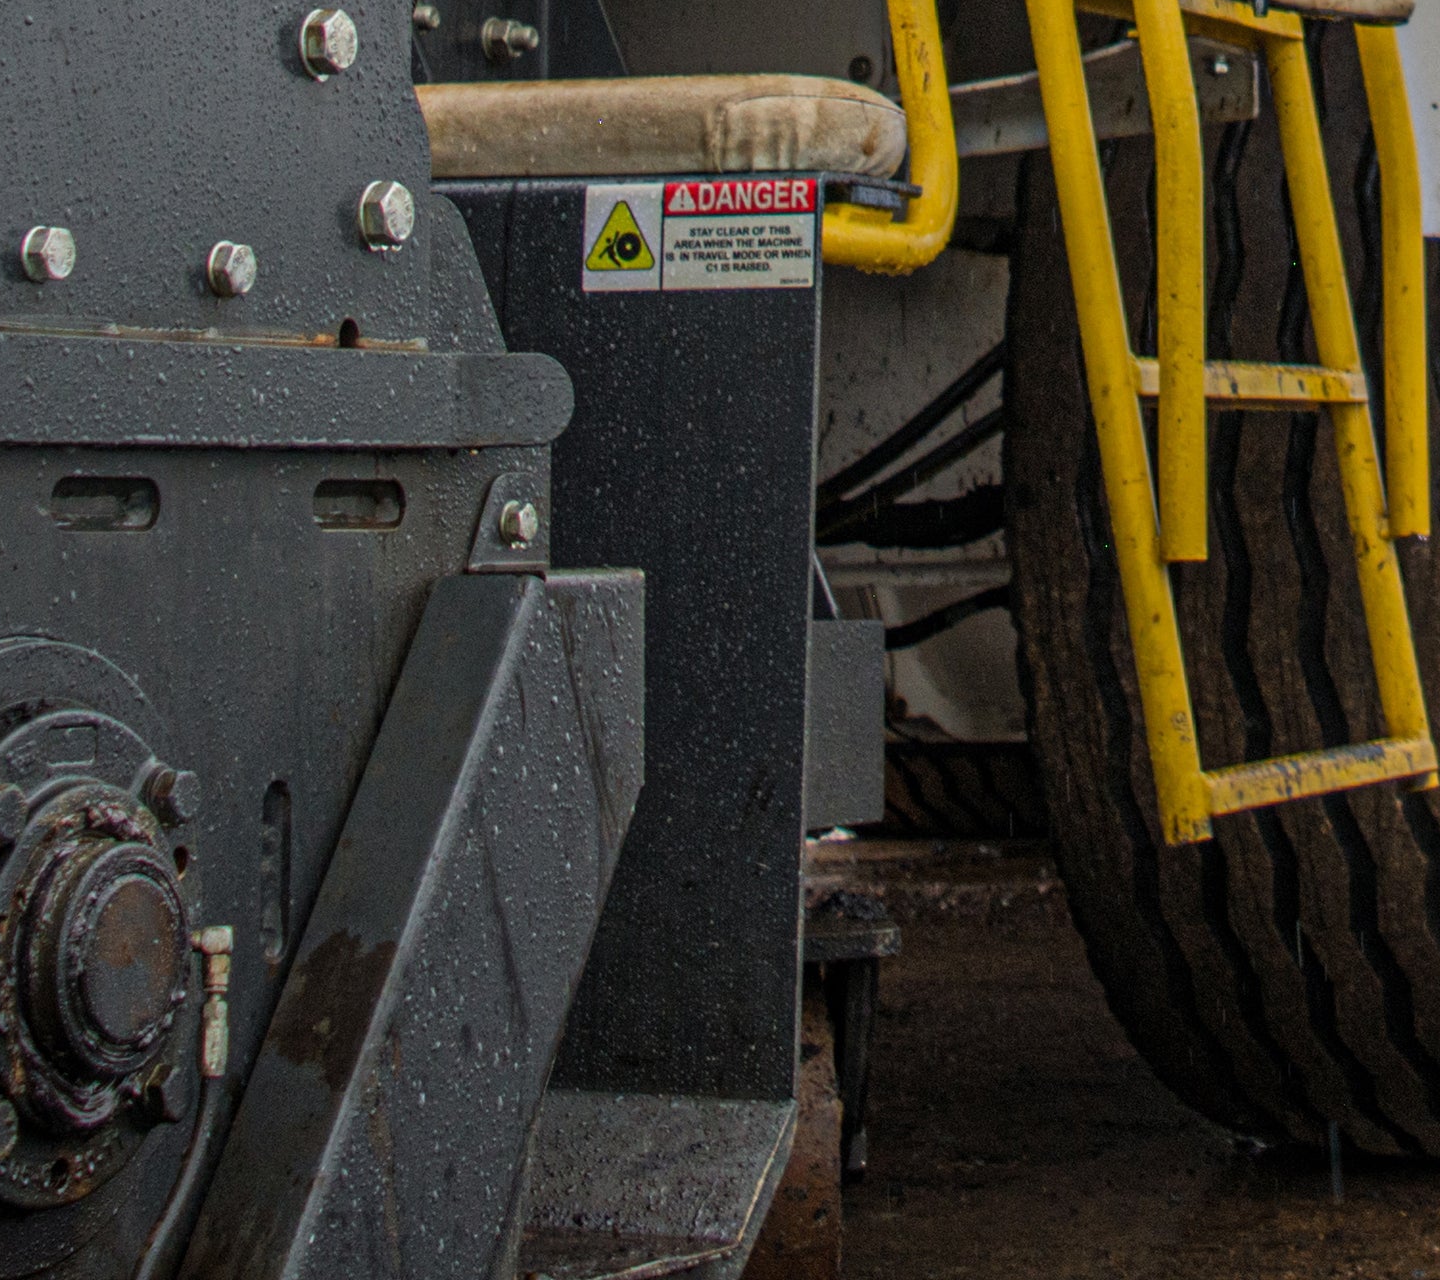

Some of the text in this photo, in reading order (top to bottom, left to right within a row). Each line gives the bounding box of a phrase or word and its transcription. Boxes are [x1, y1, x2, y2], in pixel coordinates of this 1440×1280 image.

[698, 180, 809, 211] DANGER
[689, 225, 791, 237] STAY CLEAR OF THIS
[674, 237, 803, 249] AREA WHEN THE MACHINE
[666, 249, 811, 261] IS IN TRAVEL MODE OR WHEN
[721, 262, 730, 272] IS
[732, 261, 772, 272] RAISED.
